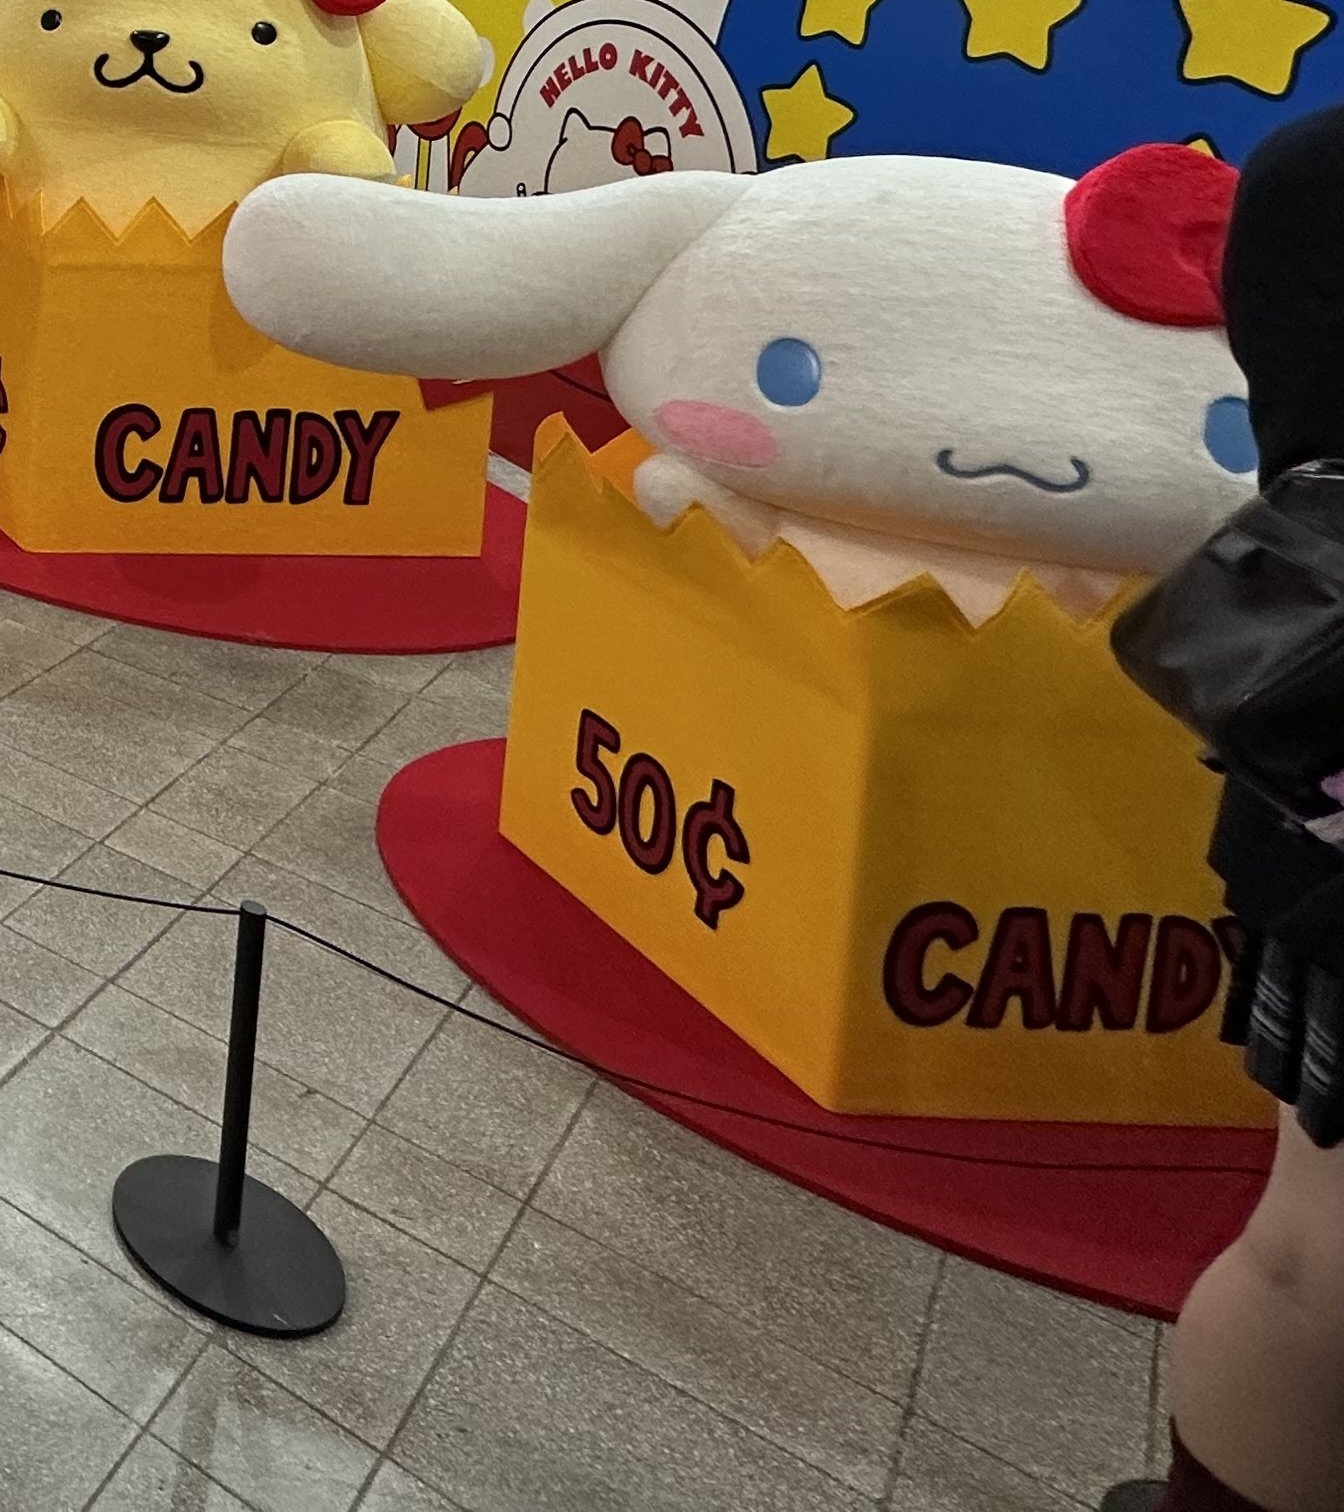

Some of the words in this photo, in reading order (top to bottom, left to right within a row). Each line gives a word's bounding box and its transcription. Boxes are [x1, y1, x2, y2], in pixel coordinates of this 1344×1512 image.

[539, 43, 617, 108] HELLO
[629, 49, 704, 138] KITTY
[94, 403, 400, 505] CANDY
[570, 708, 750, 931] 50¢
[883, 901, 1249, 1035] CAND
